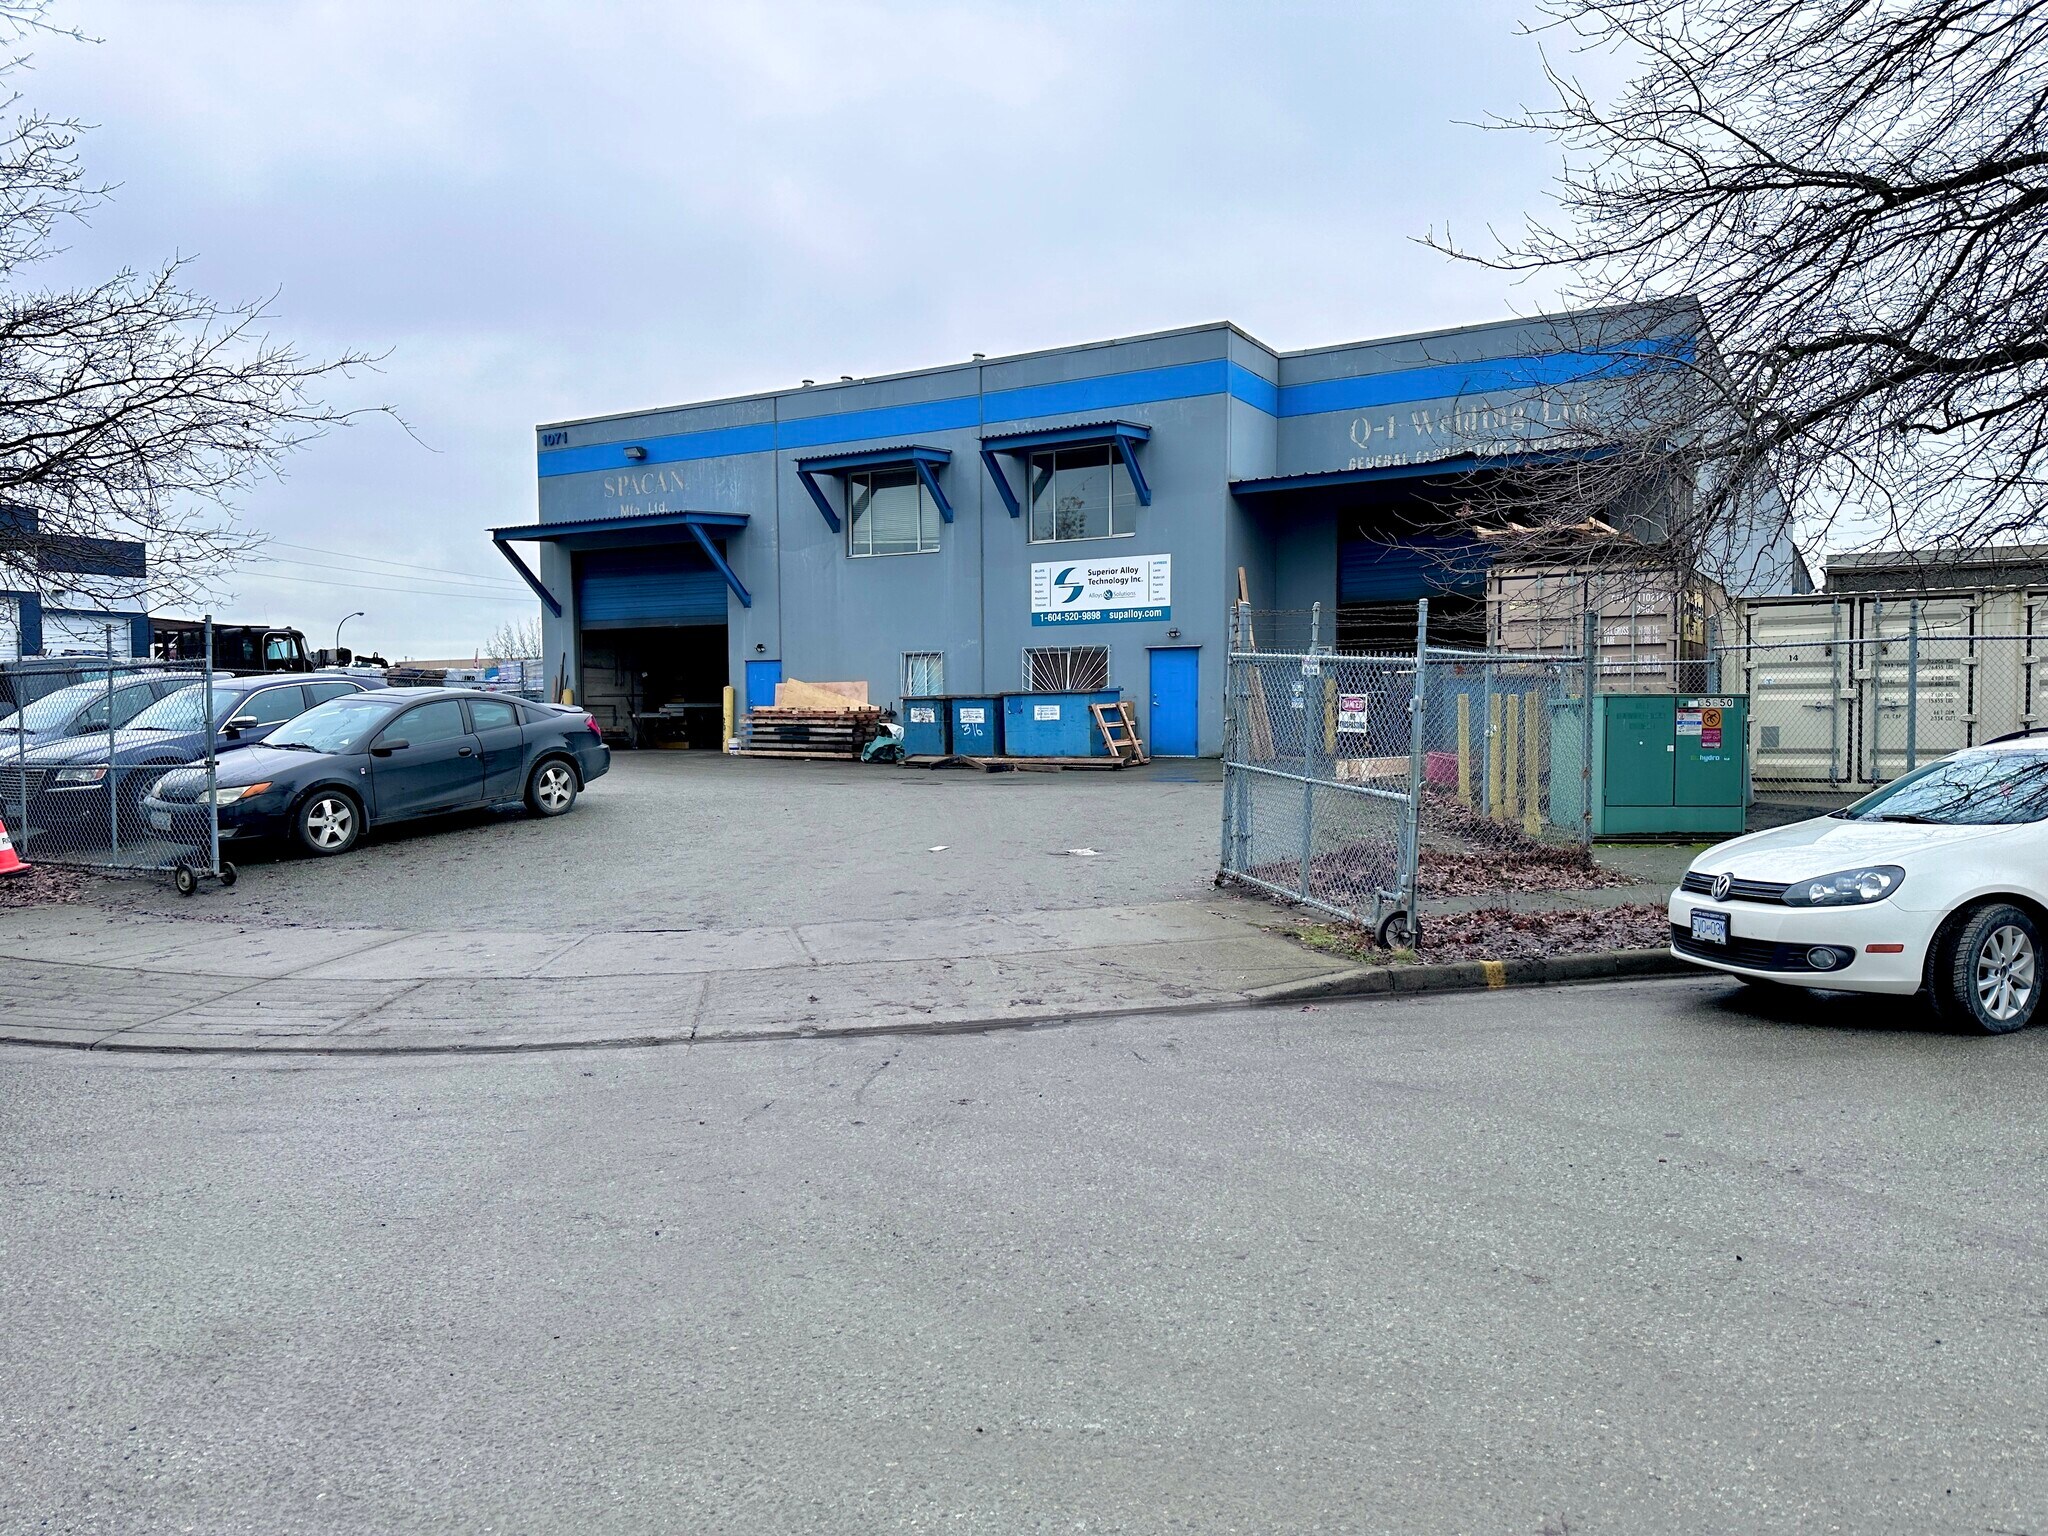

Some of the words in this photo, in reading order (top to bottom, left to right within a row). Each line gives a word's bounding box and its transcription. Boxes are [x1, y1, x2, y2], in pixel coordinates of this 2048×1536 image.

[1411, 402, 1525, 436] Welding
[541, 431, 568, 446] 1071
[604, 470, 684, 498] SPACAN
[1088, 568, 1118, 577] Superior
[1120, 566, 1139, 575] Alloy
[1088, 576, 1129, 586] Technology
[1130, 575, 1143, 583] Inc.
[1040, 610, 1101, 622] 1-604-520-9898
[1109, 608, 1162, 620] supalloy.com
[1699, 754, 1720, 762] hydro
